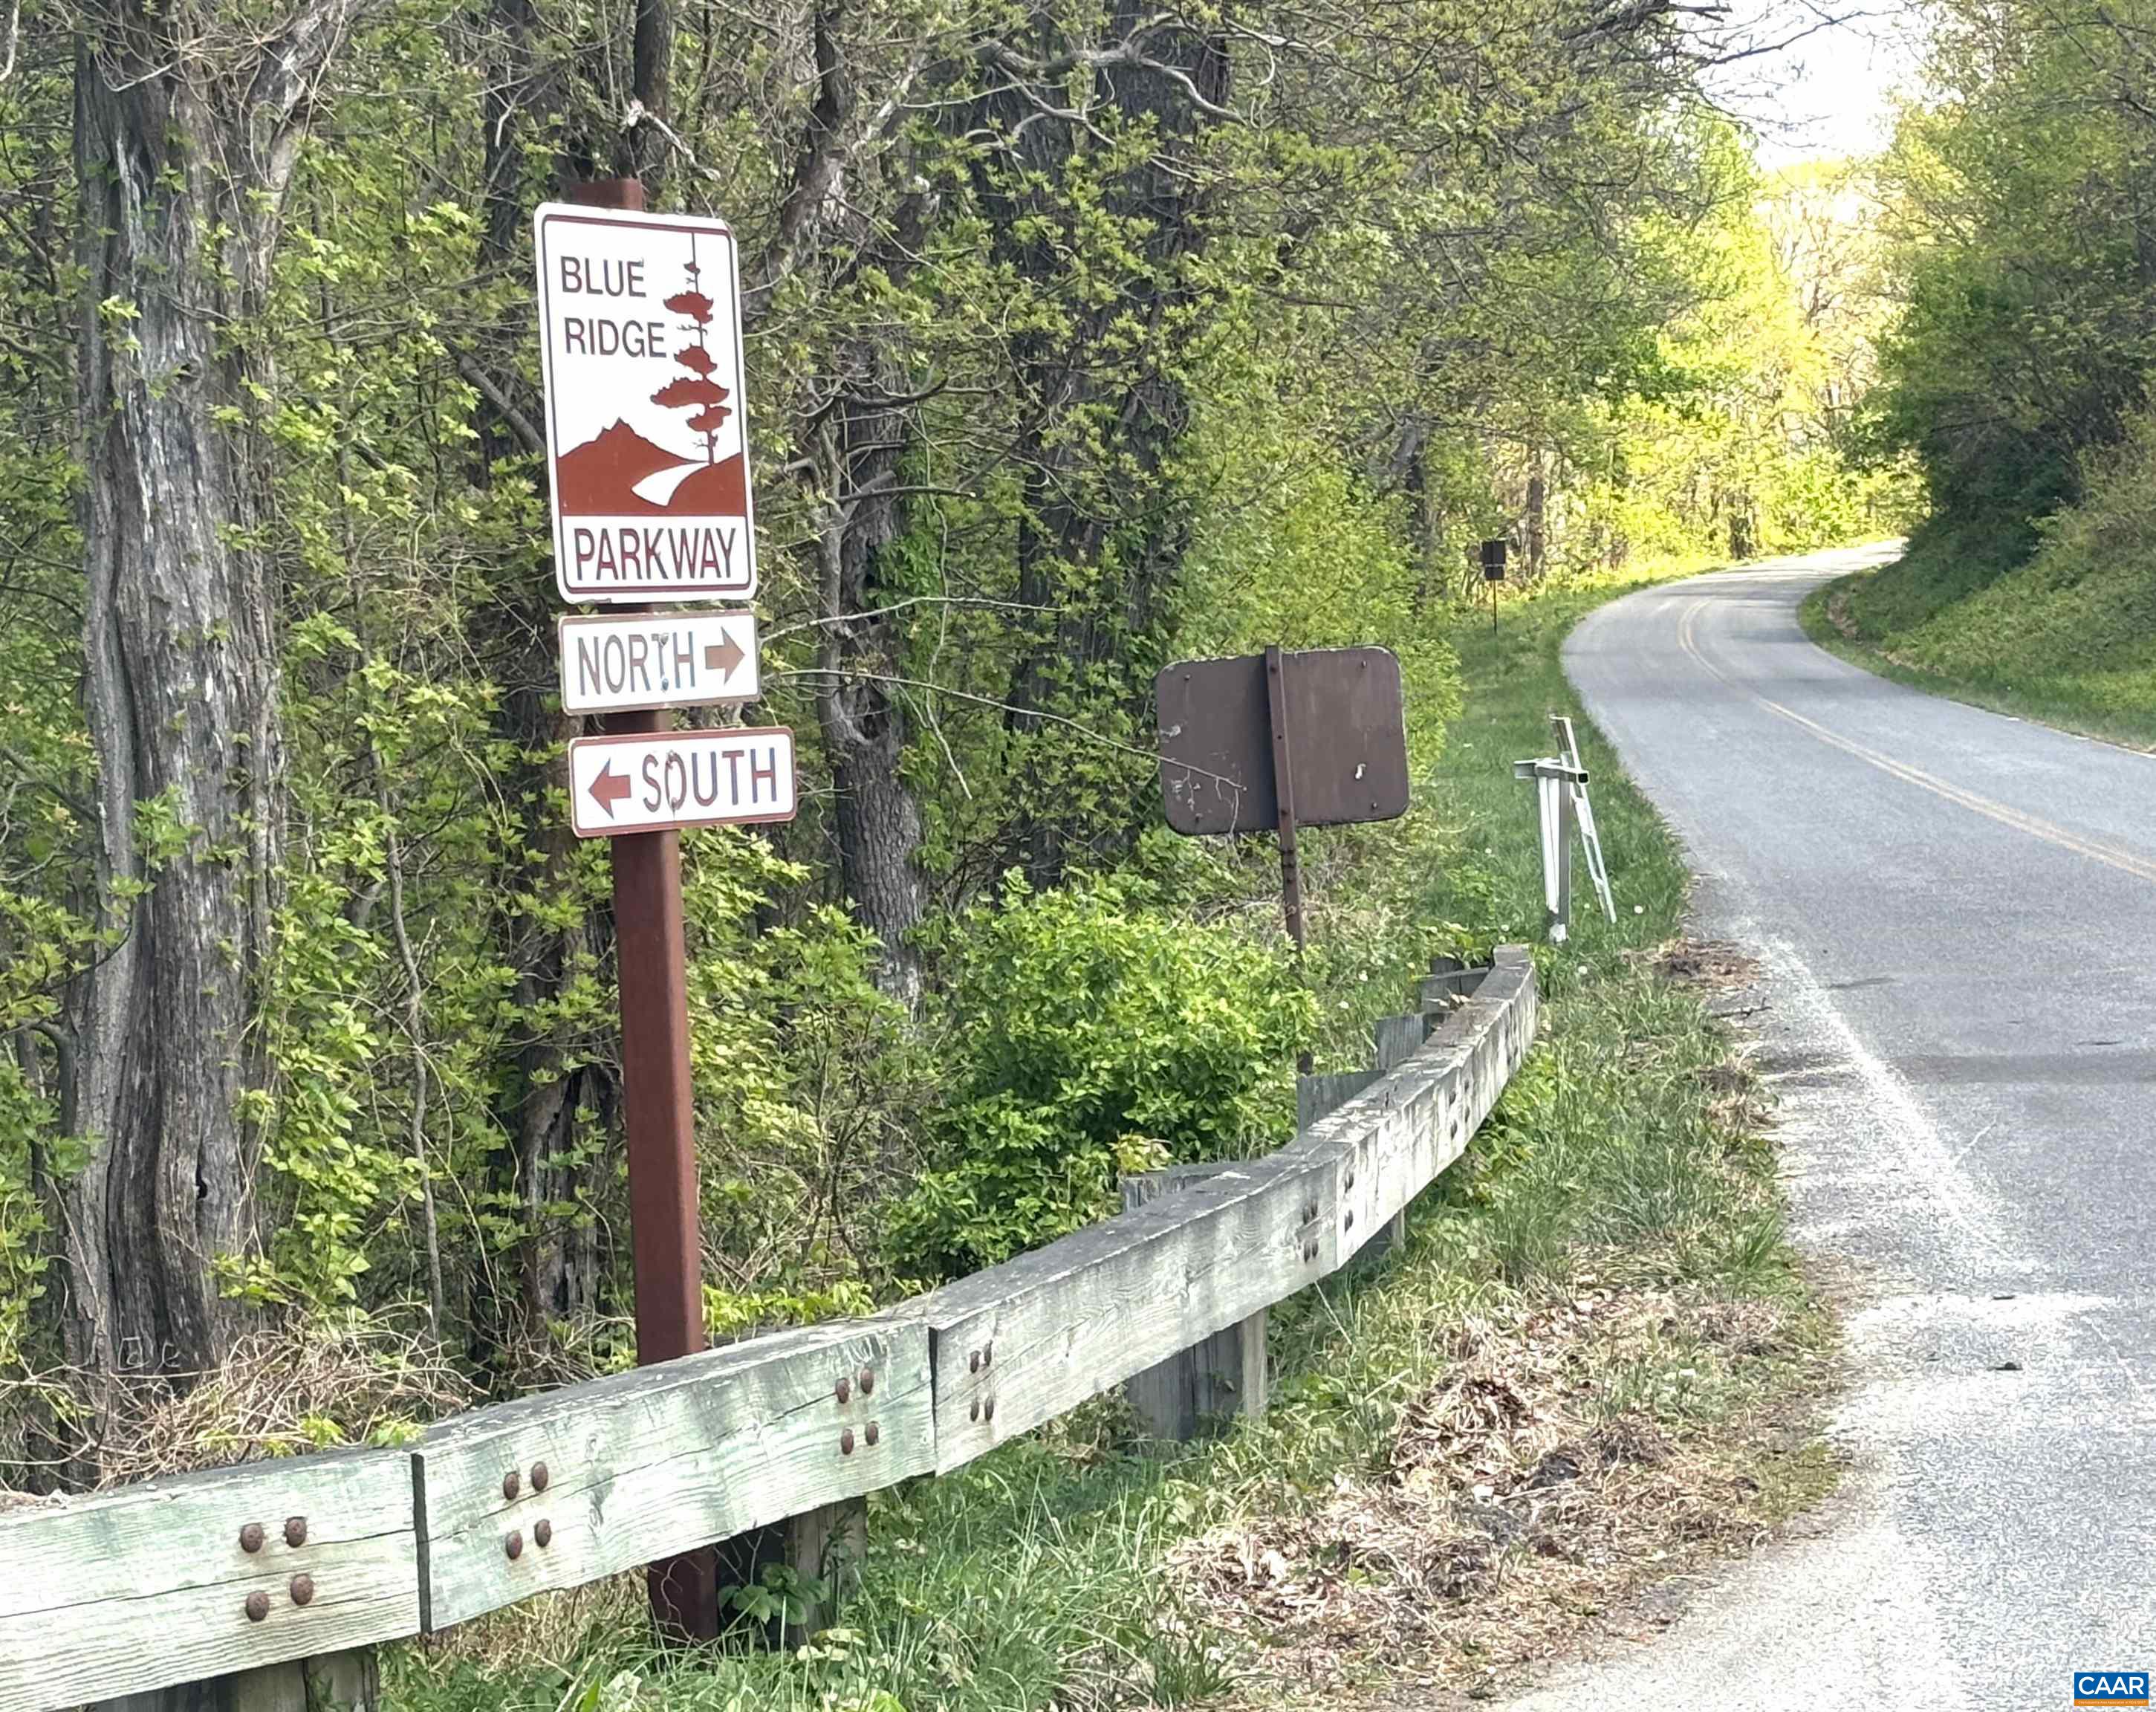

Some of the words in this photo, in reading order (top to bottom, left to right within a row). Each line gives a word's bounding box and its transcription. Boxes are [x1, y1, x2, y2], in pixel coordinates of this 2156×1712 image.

[560, 256, 646, 298] BLUE
[564, 317, 667, 358] RIDGE
[574, 528, 736, 580] PARKWAY
[577, 632, 695, 696] NORTH
[642, 747, 777, 813] SOUTH
